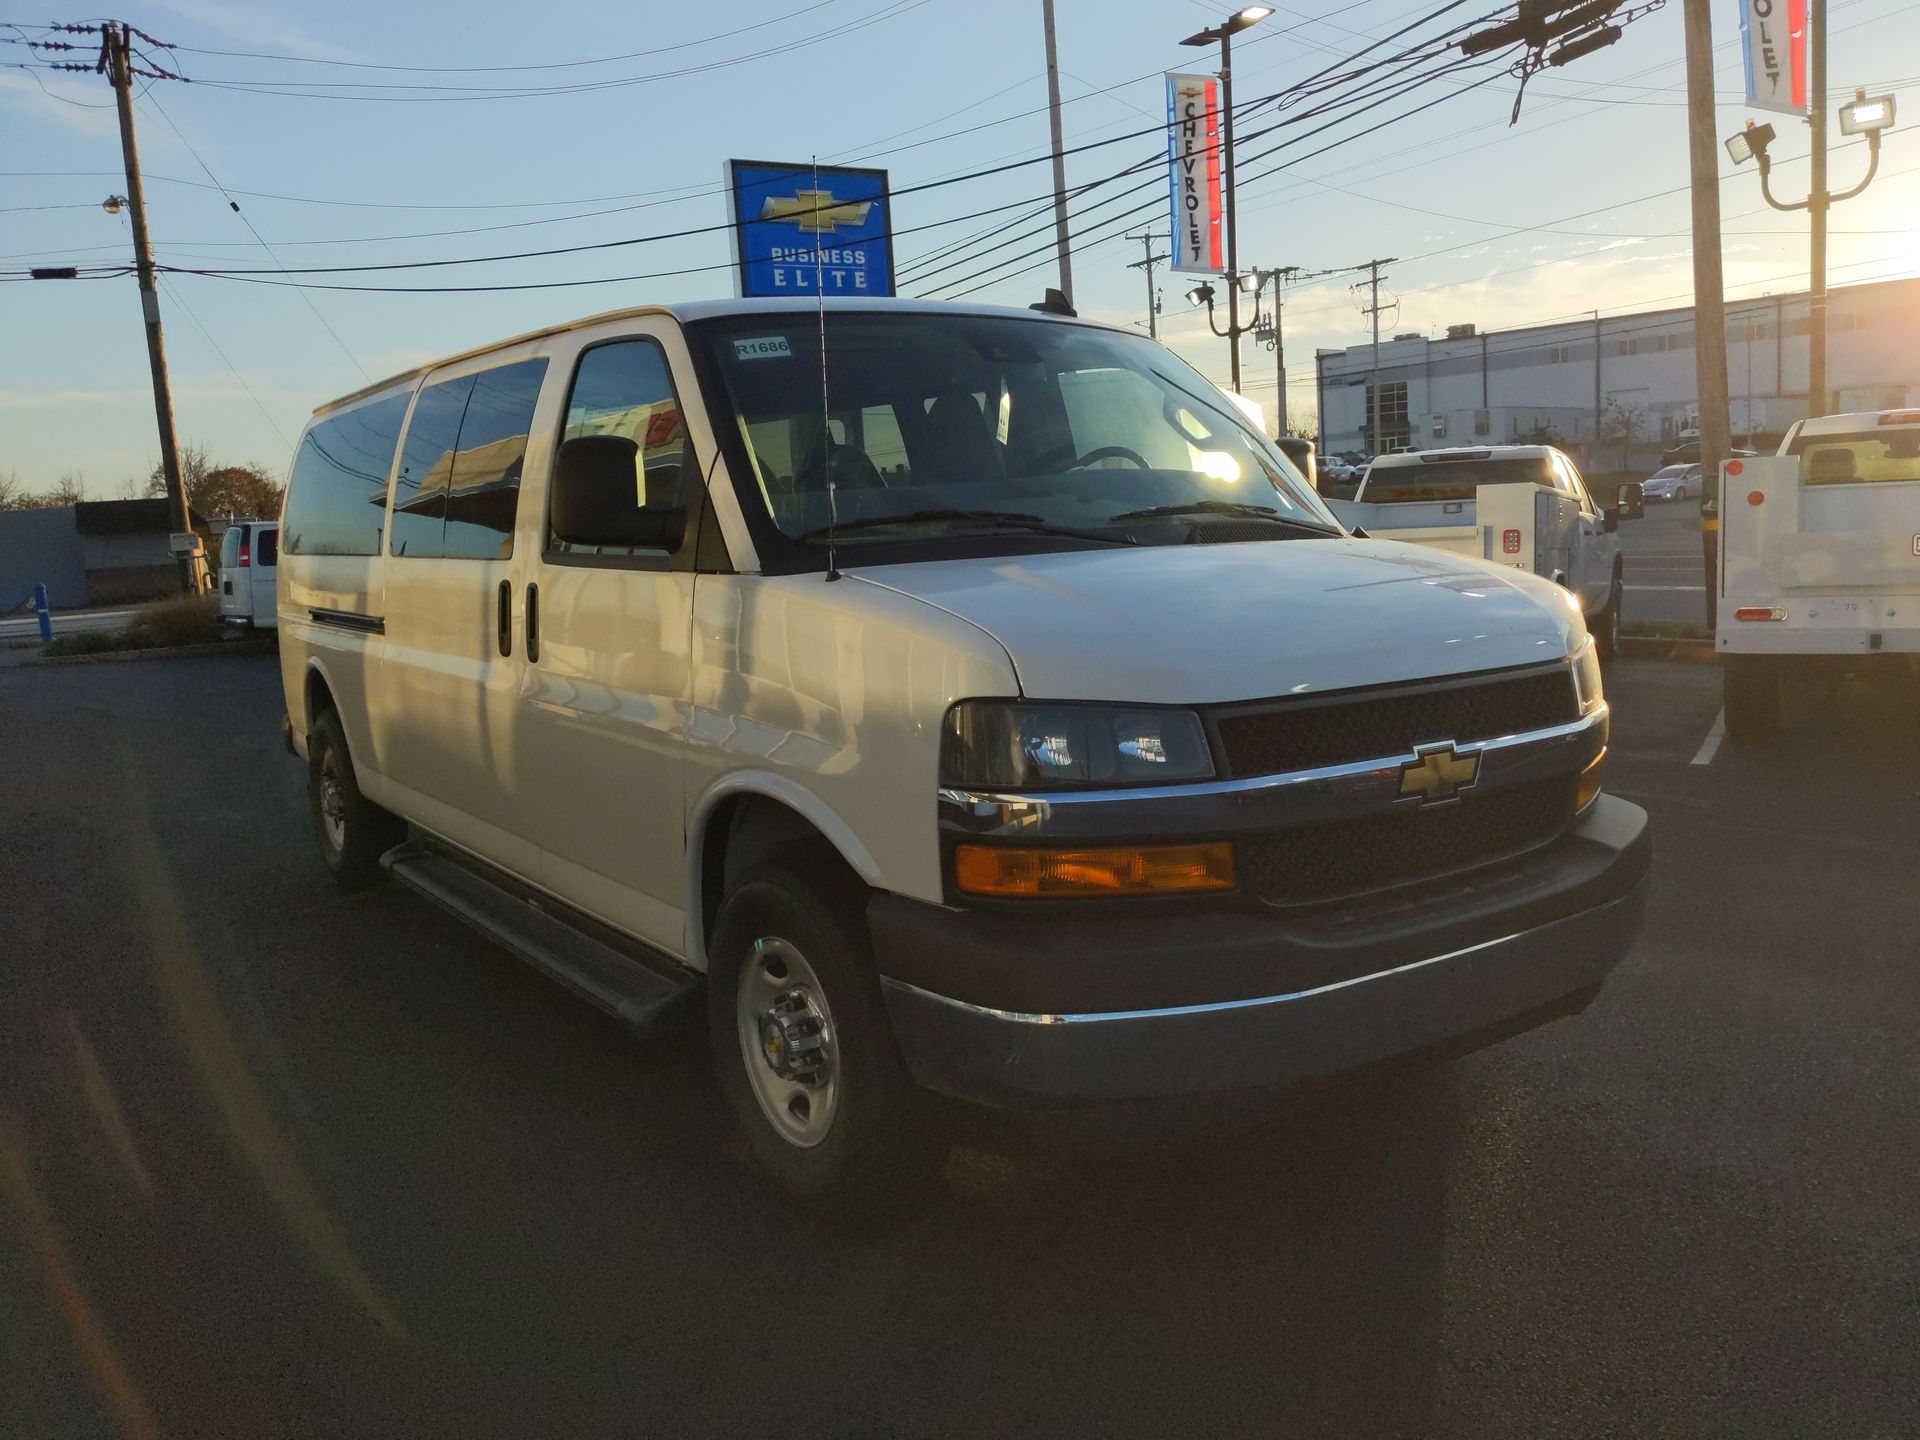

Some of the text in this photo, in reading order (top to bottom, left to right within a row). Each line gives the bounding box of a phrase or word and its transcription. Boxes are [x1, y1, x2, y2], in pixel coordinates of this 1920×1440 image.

[1183, 102, 1201, 262] CHEVROLET
[771, 247, 866, 265] BUSINESS
[773, 269, 868, 289] ELTE
[736, 341, 788, 355] R1686
